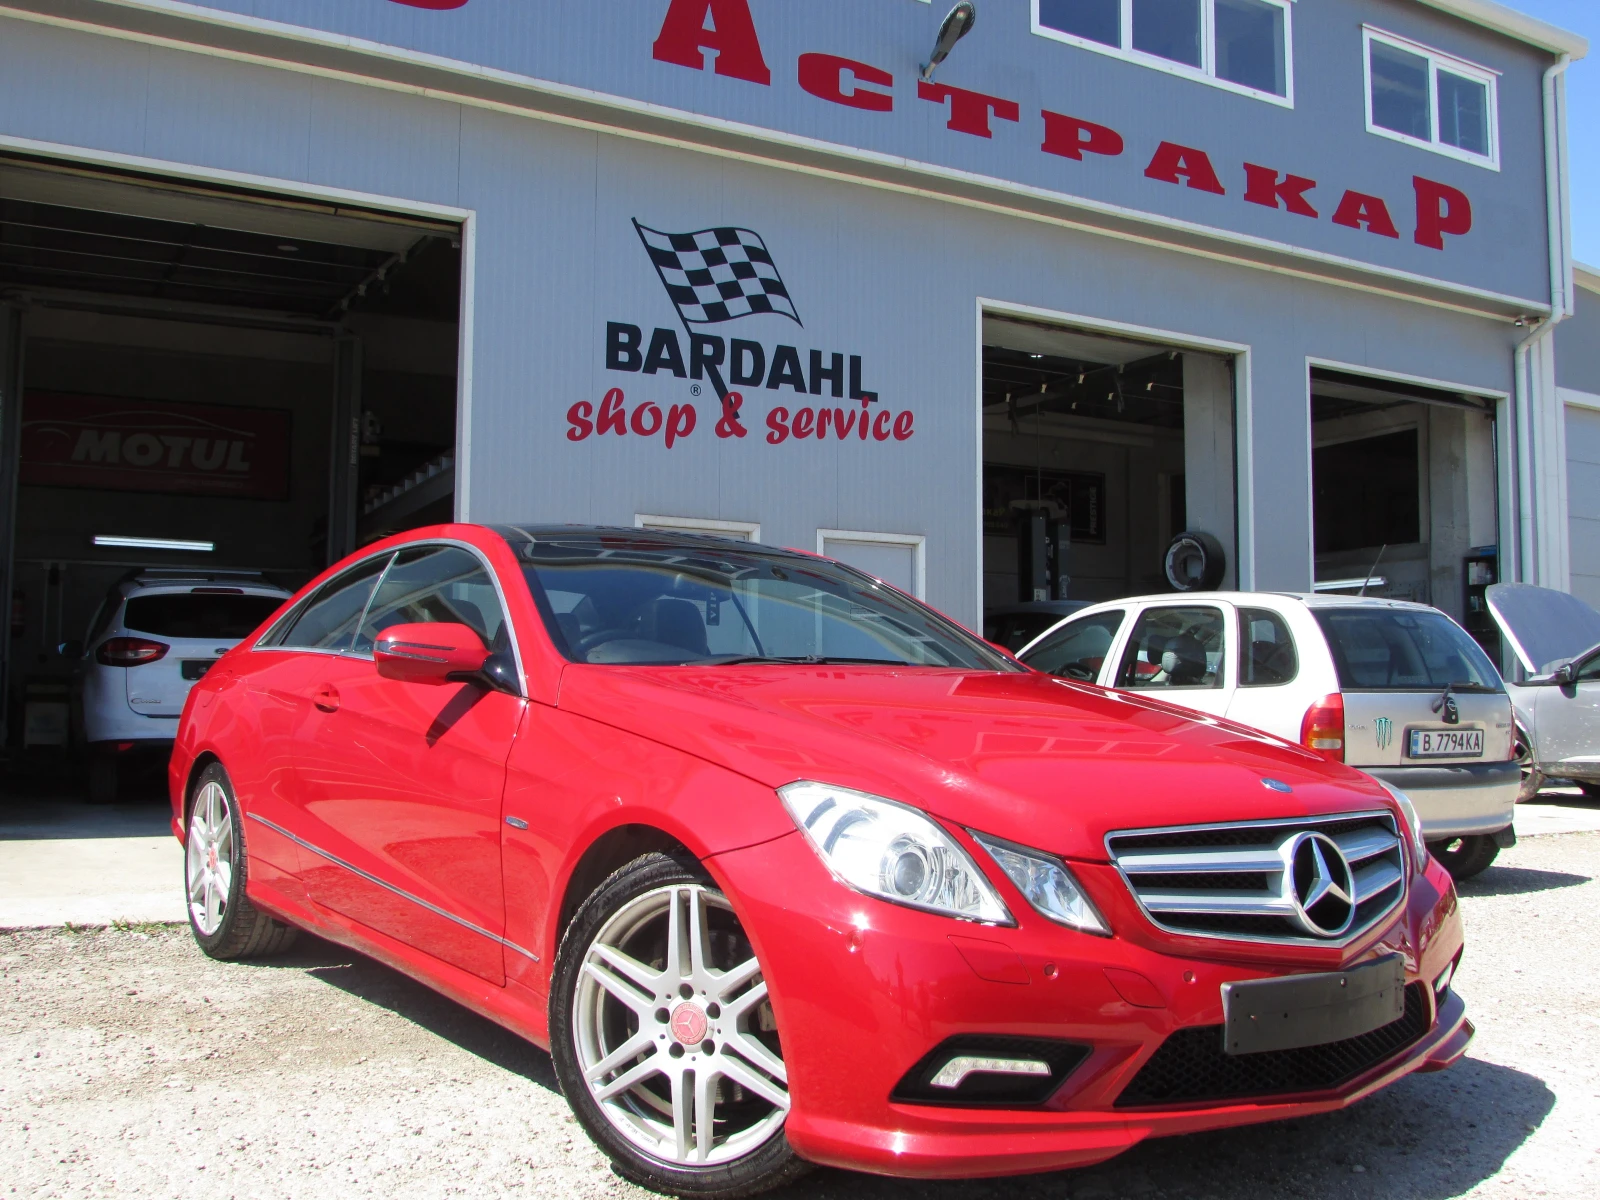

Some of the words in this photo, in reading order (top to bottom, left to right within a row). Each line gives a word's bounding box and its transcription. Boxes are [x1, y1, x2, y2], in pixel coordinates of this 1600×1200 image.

[605, 321, 878, 403] BARDAHL
[566, 387, 697, 449] shop
[714, 391, 748, 439] &
[765, 396, 914, 445] service
[71, 430, 250, 471] MOTUL
[1089, 486, 1097, 535] PRESTIGE
